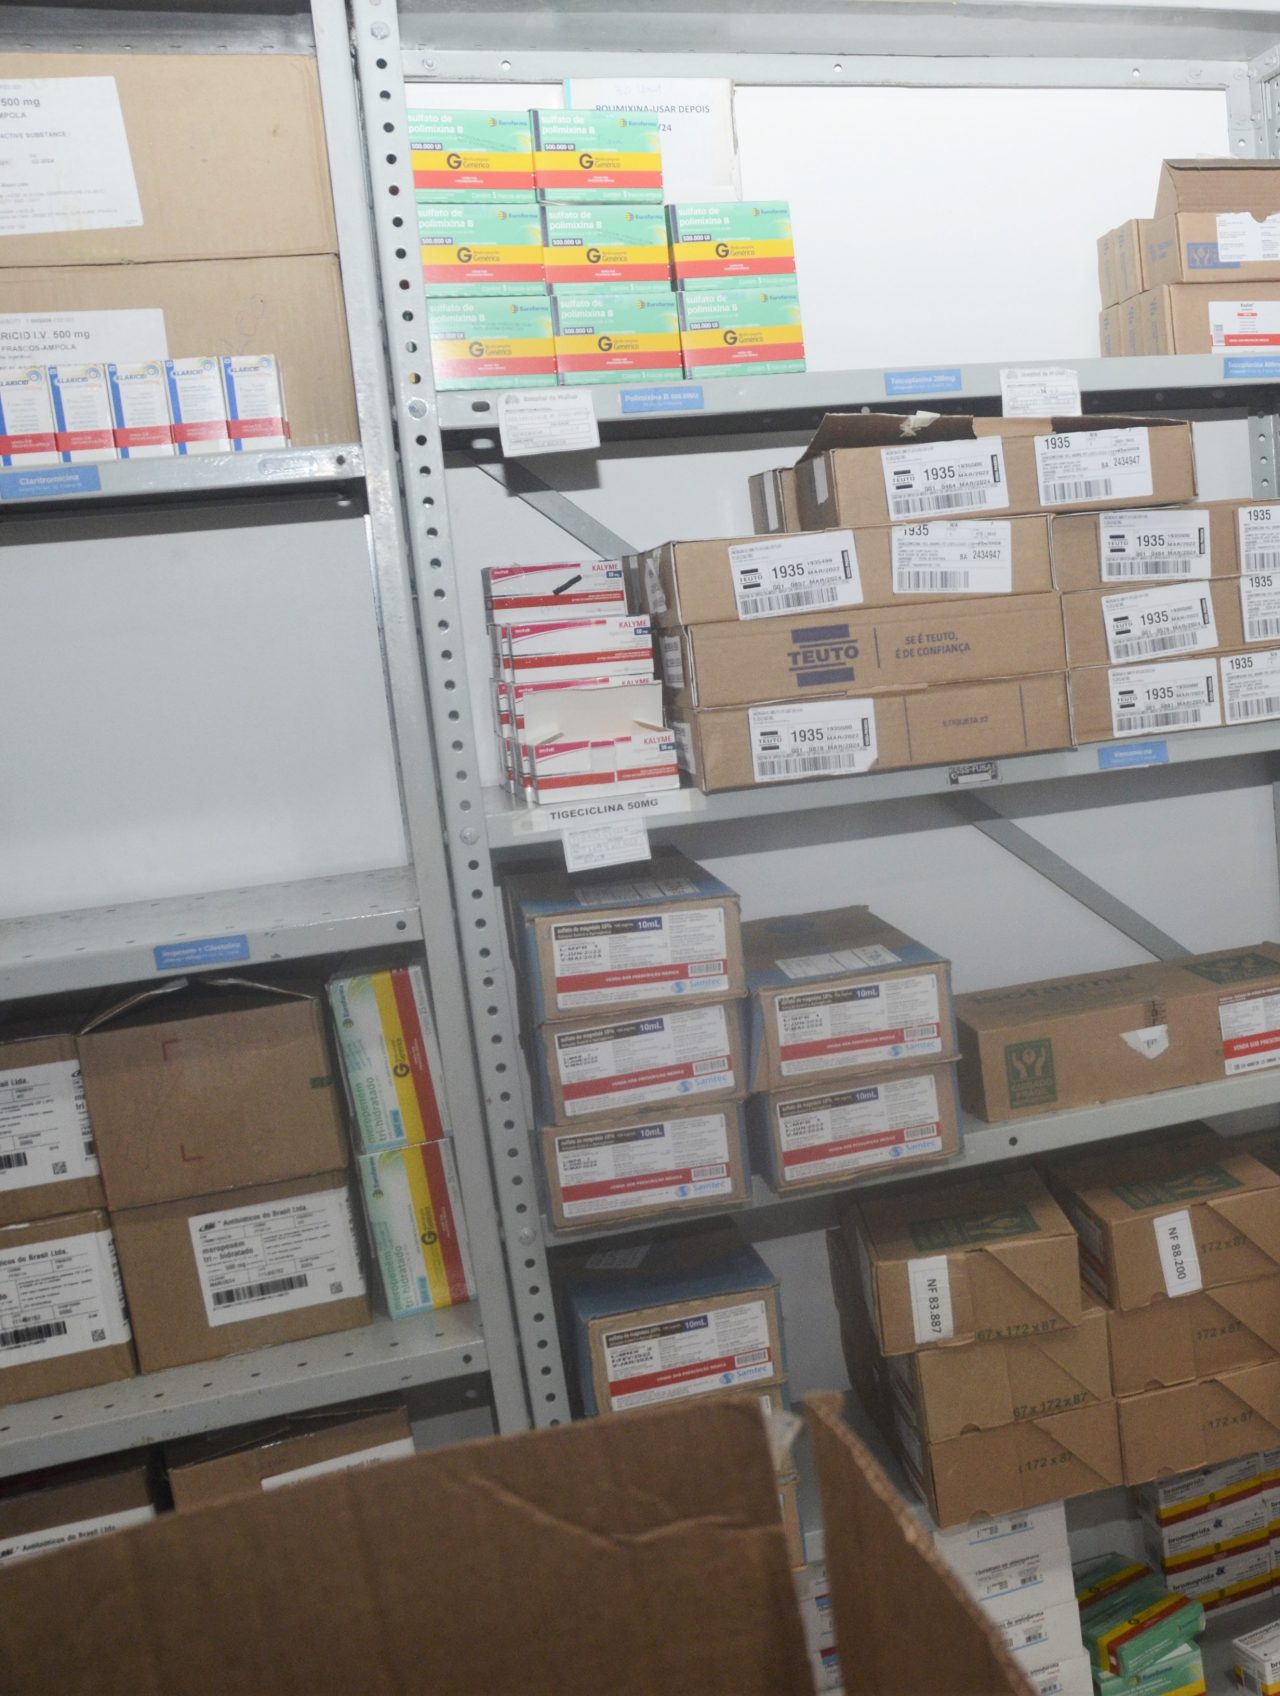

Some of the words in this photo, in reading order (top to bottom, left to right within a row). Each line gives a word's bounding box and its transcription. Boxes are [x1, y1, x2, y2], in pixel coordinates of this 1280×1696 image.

[23, 97, 41, 108] mg
[679, 105, 710, 113] DEPOIS
[542, 126, 586, 136] polimixina
[446, 153, 461, 170] G
[579, 153, 593, 169] G
[449, 209, 463, 218] de
[577, 210, 591, 219] de
[418, 220, 463, 229] polimixina
[466, 220, 474, 228] B
[550, 220, 593, 231] polimixina
[457, 247, 472, 263] G
[586, 247, 601, 264] G
[715, 242, 730, 258] G
[561, 310, 605, 319] polimixina
[33, 330, 51, 340] I.V.
[53, 330, 71, 339] 500
[74, 330, 91, 341] mg
[724, 330, 738, 346] G
[469, 341, 484, 357] G
[598, 336, 612, 352] G
[1044, 437, 1071, 450] 1935
[924, 465, 955, 481] 1935
[1247, 508, 1271, 521] 1935
[903, 525, 930, 537] 1935
[1136, 533, 1165, 548] 1935
[592, 563, 619, 572] KALYME
[772, 563, 805, 579] 1935
[1249, 575, 1273, 588] 1935
[618, 619, 648, 629] KALYME
[1141, 610, 1169, 626] 1935
[905, 635, 916, 645] SE
[917, 633, 923, 644] É
[925, 632, 958, 643] TEUTO,
[788, 645, 859, 666] TEUTO
[896, 647, 902, 659] É
[903, 648, 915, 658] DE
[917, 643, 971, 657] CONFIANÇA
[1229, 657, 1253, 670] 1935
[1145, 686, 1174, 701] 1935
[643, 734, 673, 745] KALYME
[791, 728, 824, 743] 1935
[550, 803, 624, 821] TIGECICLINA
[628, 799, 659, 810] 50MG
[637, 919, 661, 930] 10mL
[689, 978, 722, 989] Samtec
[856, 989, 878, 999] 10mL
[639, 1021, 663, 1032] 10mL
[694, 1074, 728, 1087] Samtec
[855, 1089, 877, 1100] 10mL
[640, 1127, 663, 1138] 10mL
[692, 1177, 726, 1190] Samtec
[273, 1207, 290, 1217] Brasil
[1168, 1226, 1180, 1240] NF
[28, 1251, 49, 1261] Brasil
[1171, 1244, 1187, 1280] 88.200
[926, 1278, 938, 1293] NF
[928, 1297, 942, 1335] 83.887
[685, 1319, 707, 1329] 10mL
[1006, 1323, 1030, 1336] 172
[1027, 1458, 1048, 1470] 172
